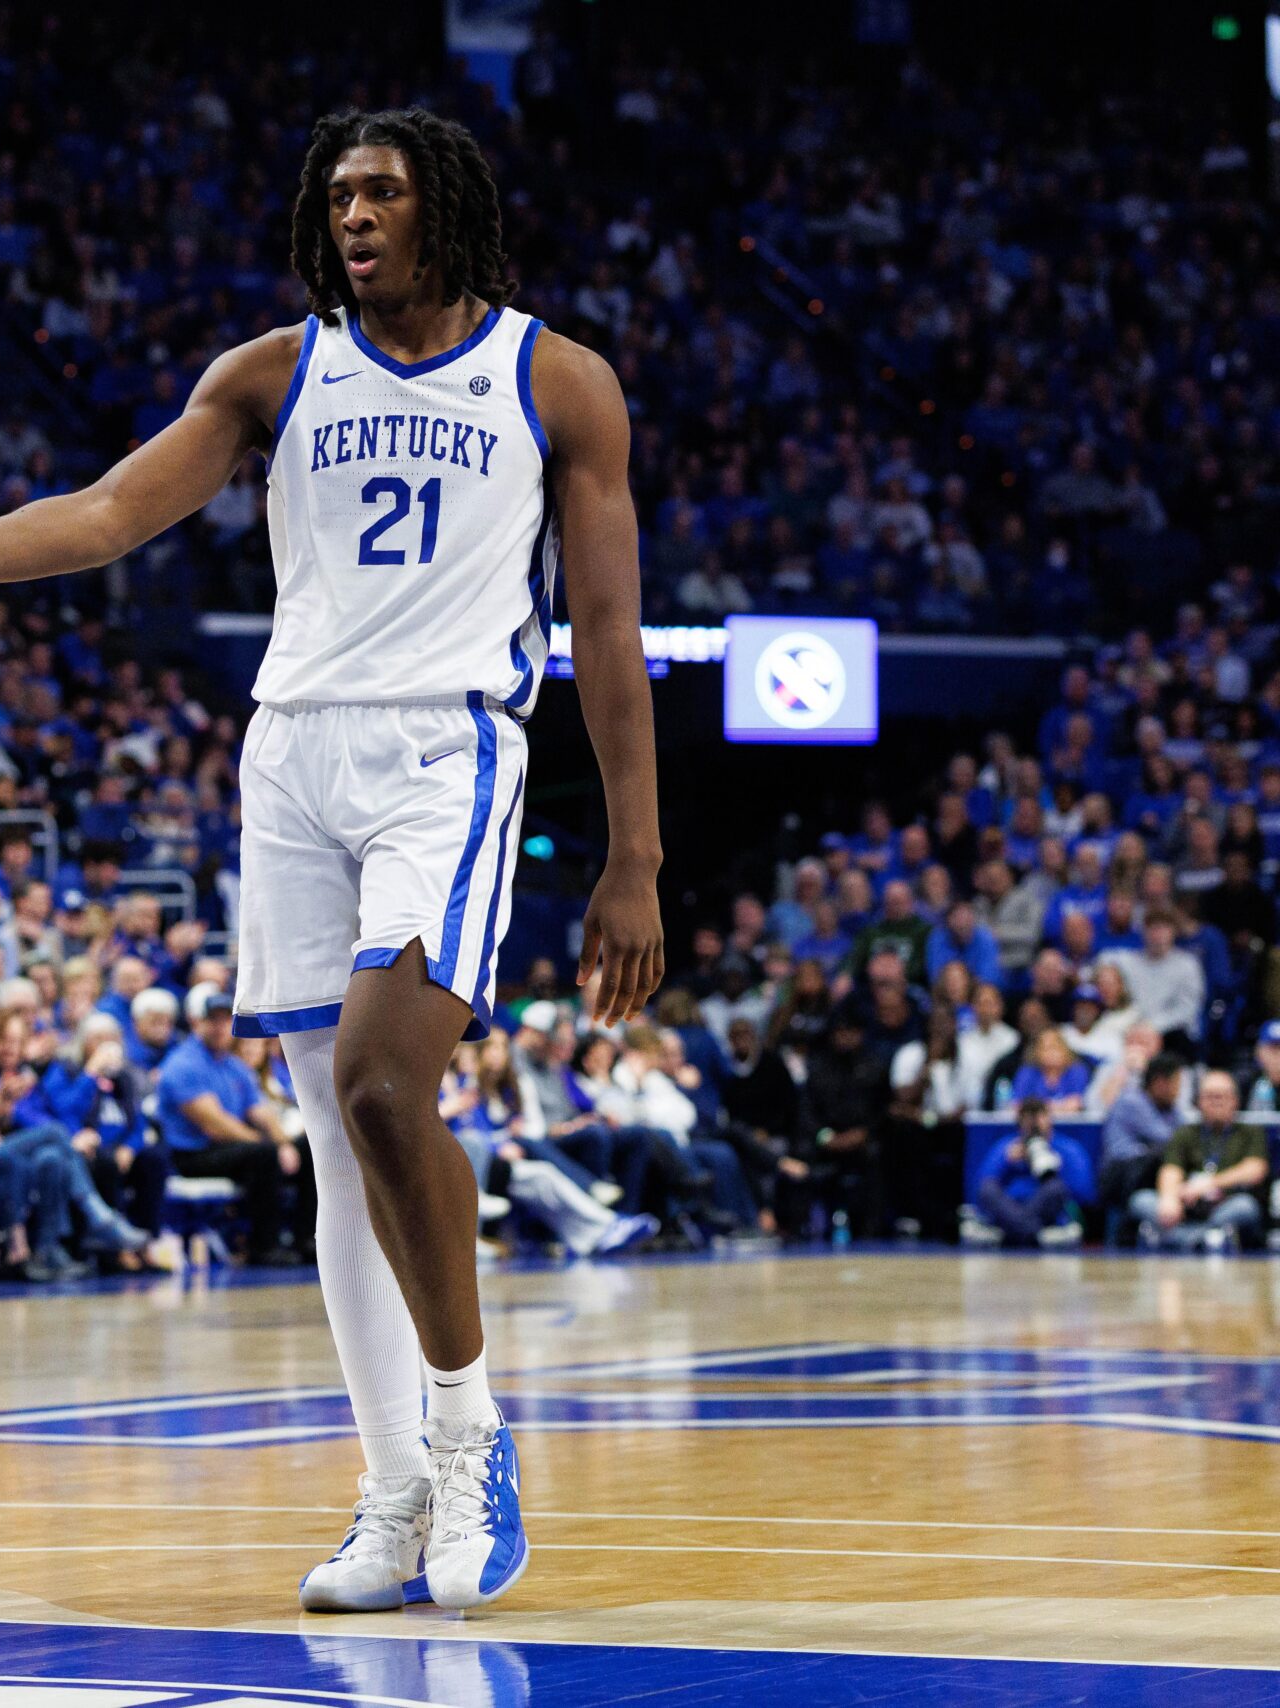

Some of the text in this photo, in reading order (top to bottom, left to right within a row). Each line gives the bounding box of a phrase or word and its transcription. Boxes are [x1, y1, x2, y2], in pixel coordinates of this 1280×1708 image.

[470, 376, 490, 395] SEC
[311, 415, 498, 477] KENTUCKY
[358, 477, 441, 565] 21
